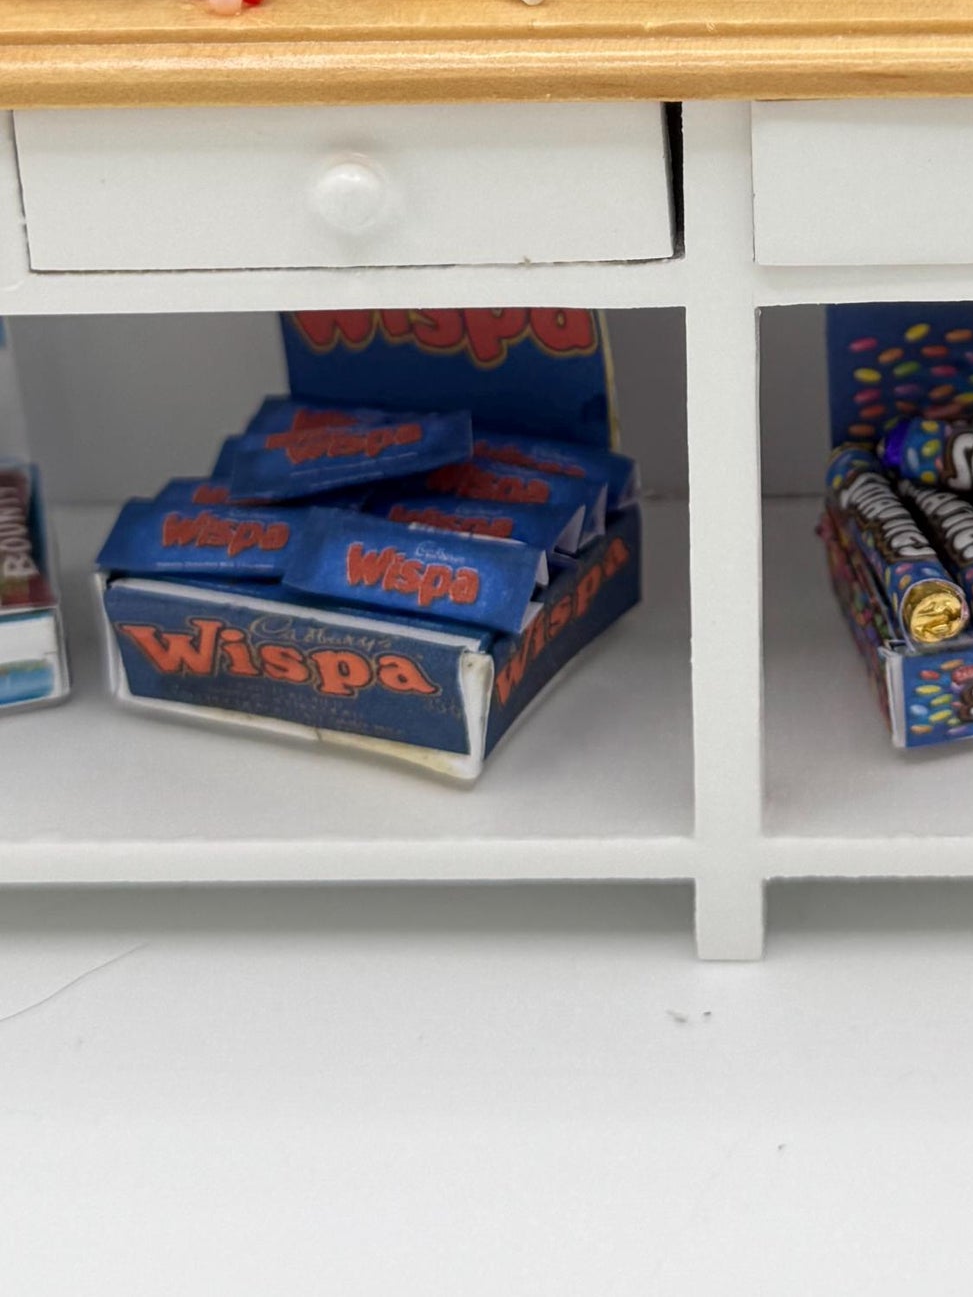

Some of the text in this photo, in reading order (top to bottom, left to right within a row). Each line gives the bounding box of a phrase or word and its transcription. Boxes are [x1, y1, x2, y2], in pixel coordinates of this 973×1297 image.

[161, 509, 290, 558] Wispa
[345, 540, 481, 607] Wispa
[116, 616, 442, 698] Wispa
